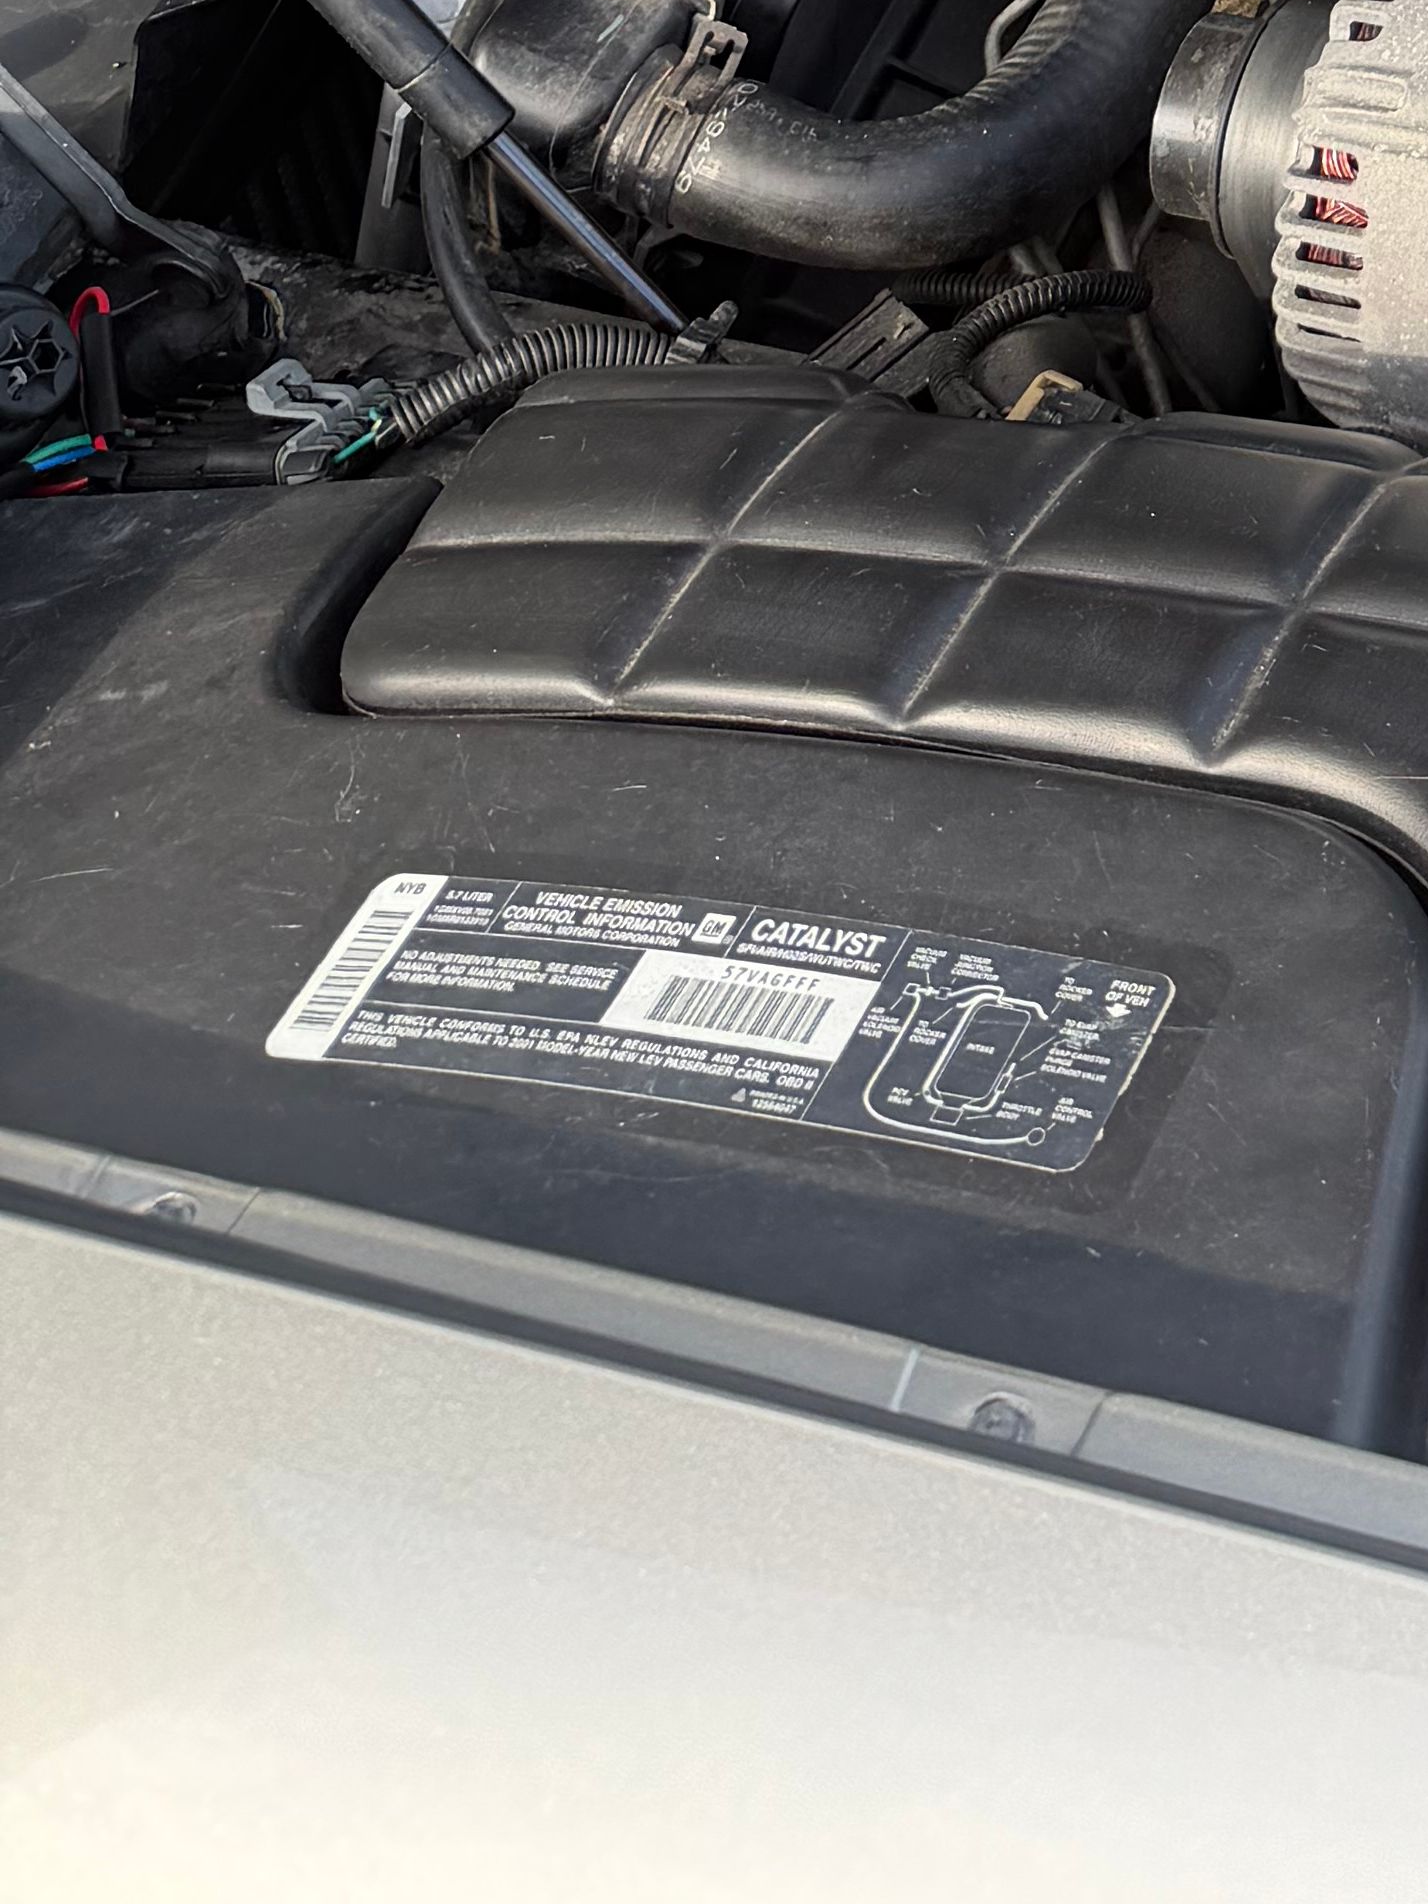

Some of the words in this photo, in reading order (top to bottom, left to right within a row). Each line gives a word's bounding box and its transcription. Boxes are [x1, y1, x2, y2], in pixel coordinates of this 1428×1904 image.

[395, 882, 427, 895] NYB
[445, 891, 466, 901] 5.7
[466, 892, 493, 903] LITER
[536, 891, 601, 910] VEHICLE
[604, 897, 682, 919] EMISSION
[502, 905, 575, 924] CONTROL
[583, 913, 693, 937] INFORMATION
[504, 921, 553, 934] GENERAL
[556, 926, 600, 939] MOTORS
[600, 929, 680, 947] CORPORATION
[702, 919, 728, 937] GM
[751, 919, 886, 958] CATALYST
[393, 962, 439, 974] MANUAL
[440, 965, 465, 976] AND
[466, 967, 545, 983] MAINTENANCE
[548, 974, 612, 991] SCHEDULE
[401, 951, 417, 960] NO
[419, 952, 496, 968] ADJUSTMENTS
[546, 962, 568, 973] SEE
[569, 964, 618, 978] SERVICE
[387, 972, 411, 982] FOR
[411, 974, 439, 985] MORE
[1110, 979, 1156, 995] FRONT
[1105, 992, 1124, 1002] OF
[1125, 994, 1151, 1007] VEH
[349, 1022, 423, 1040] REGULATIONS
[422, 1029, 491, 1045] APPLICABLE
[492, 1035, 508, 1046] TO
[610, 1050, 637, 1063] NEW
[638, 1053, 663, 1066] LEV
[663, 1056, 734, 1077] PASSENGER
[776, 1075, 805, 1089] OBD
[357, 1011, 383, 1022] THIS
[387, 1013, 436, 1028] VEHICLE
[440, 1018, 504, 1035] CONFORMS
[508, 1024, 526, 1035] TO
[559, 1029, 581, 1042] EPA
[585, 1033, 618, 1048] NLEV
[622, 1038, 708, 1060] REGULATIONS
[711, 1052, 740, 1063] AND
[744, 1057, 820, 1078] CALIFORNIA
[966, 1043, 995, 1054] INTAKE
